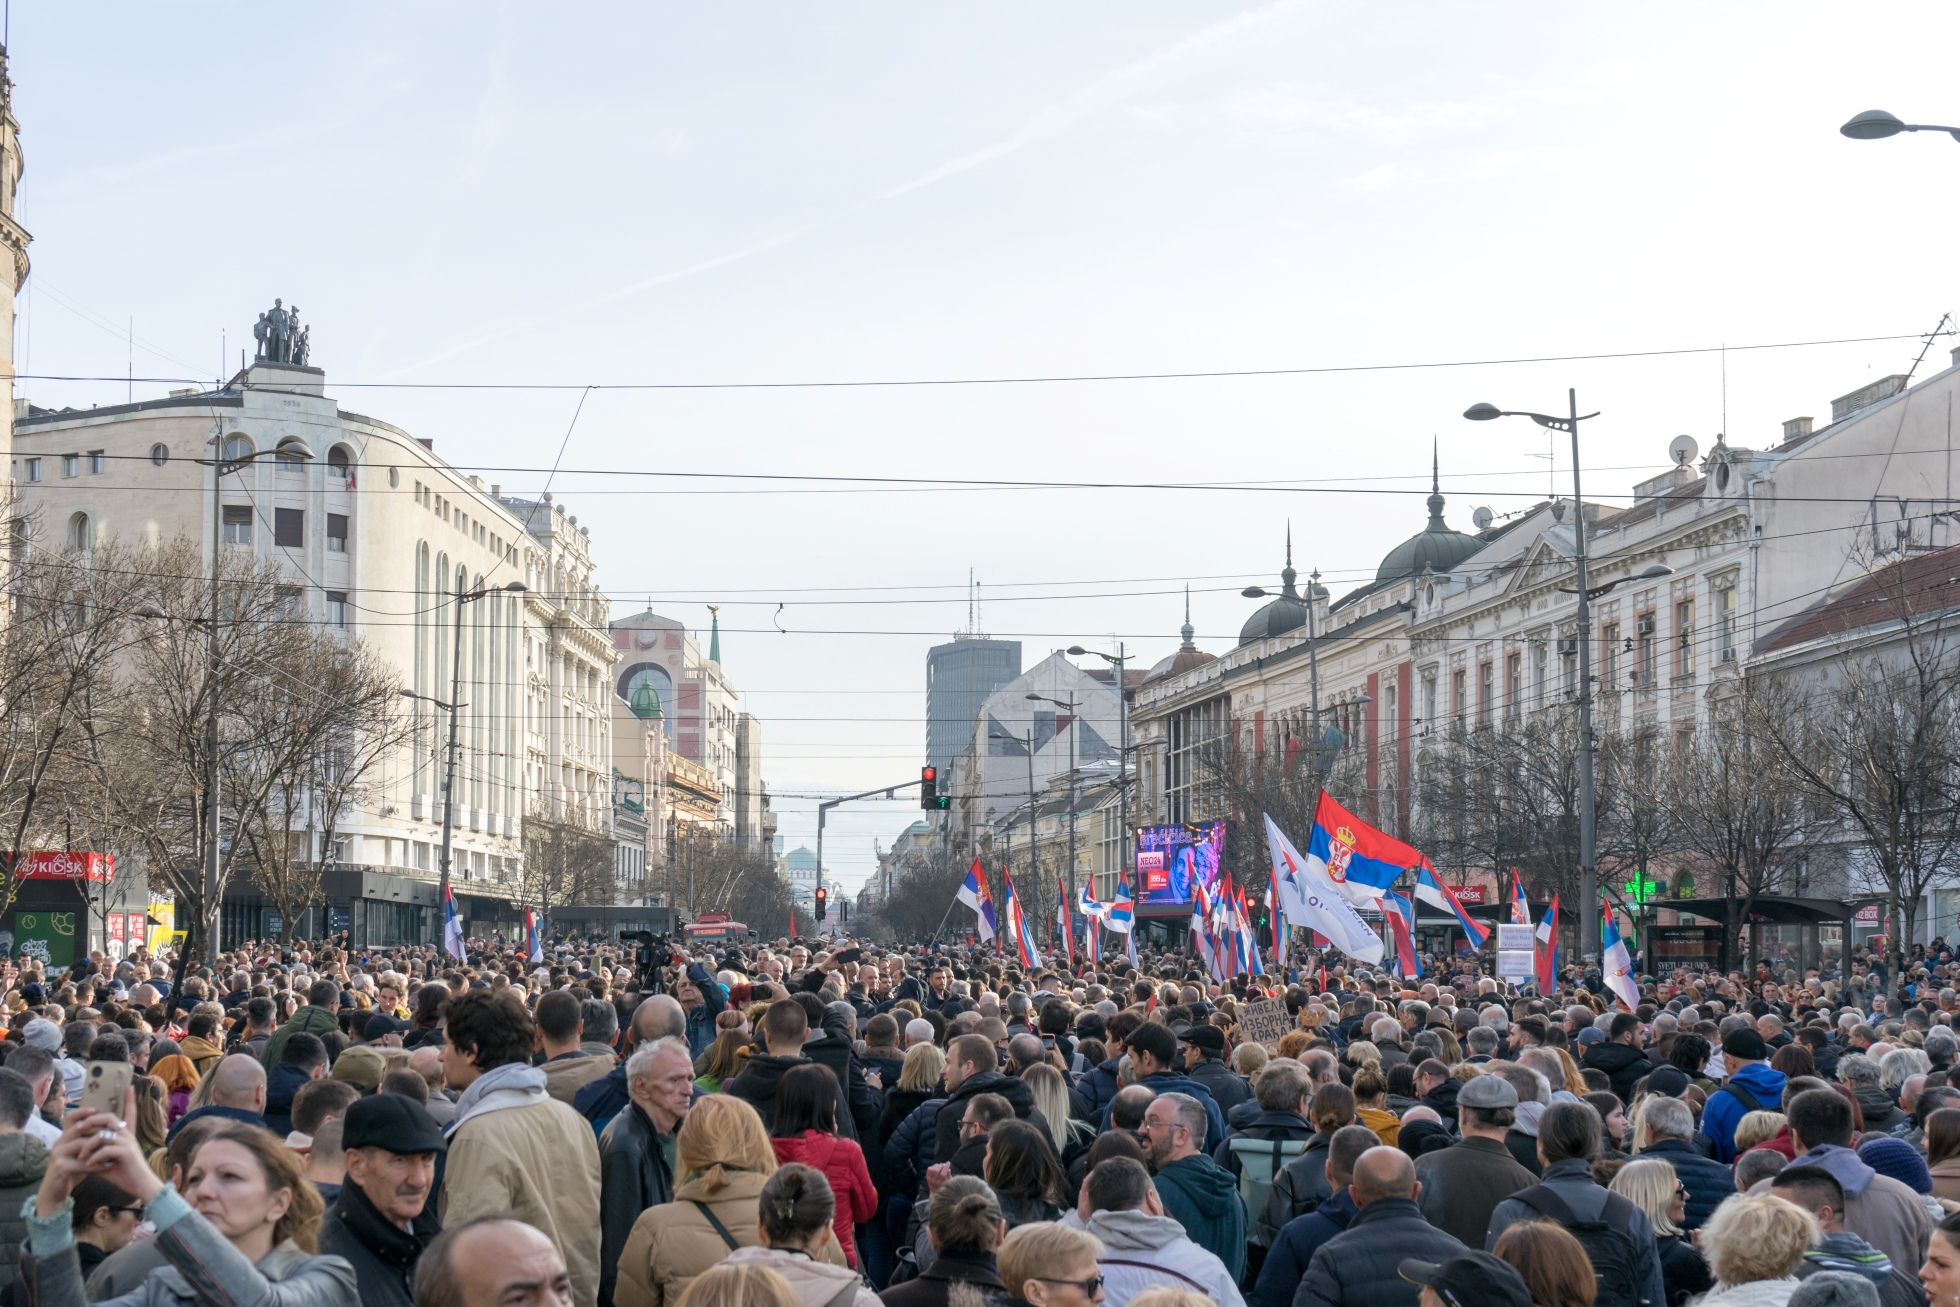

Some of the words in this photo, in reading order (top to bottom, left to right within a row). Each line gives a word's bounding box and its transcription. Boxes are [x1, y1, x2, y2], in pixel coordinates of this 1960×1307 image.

[39, 858, 83, 874] KIOSK
[1140, 857, 1161, 866] NEO24
[1150, 874, 1161, 883] 999
[1864, 910, 1878, 919] BOX
[1240, 1012, 1291, 1031] ИЗБОРНА
